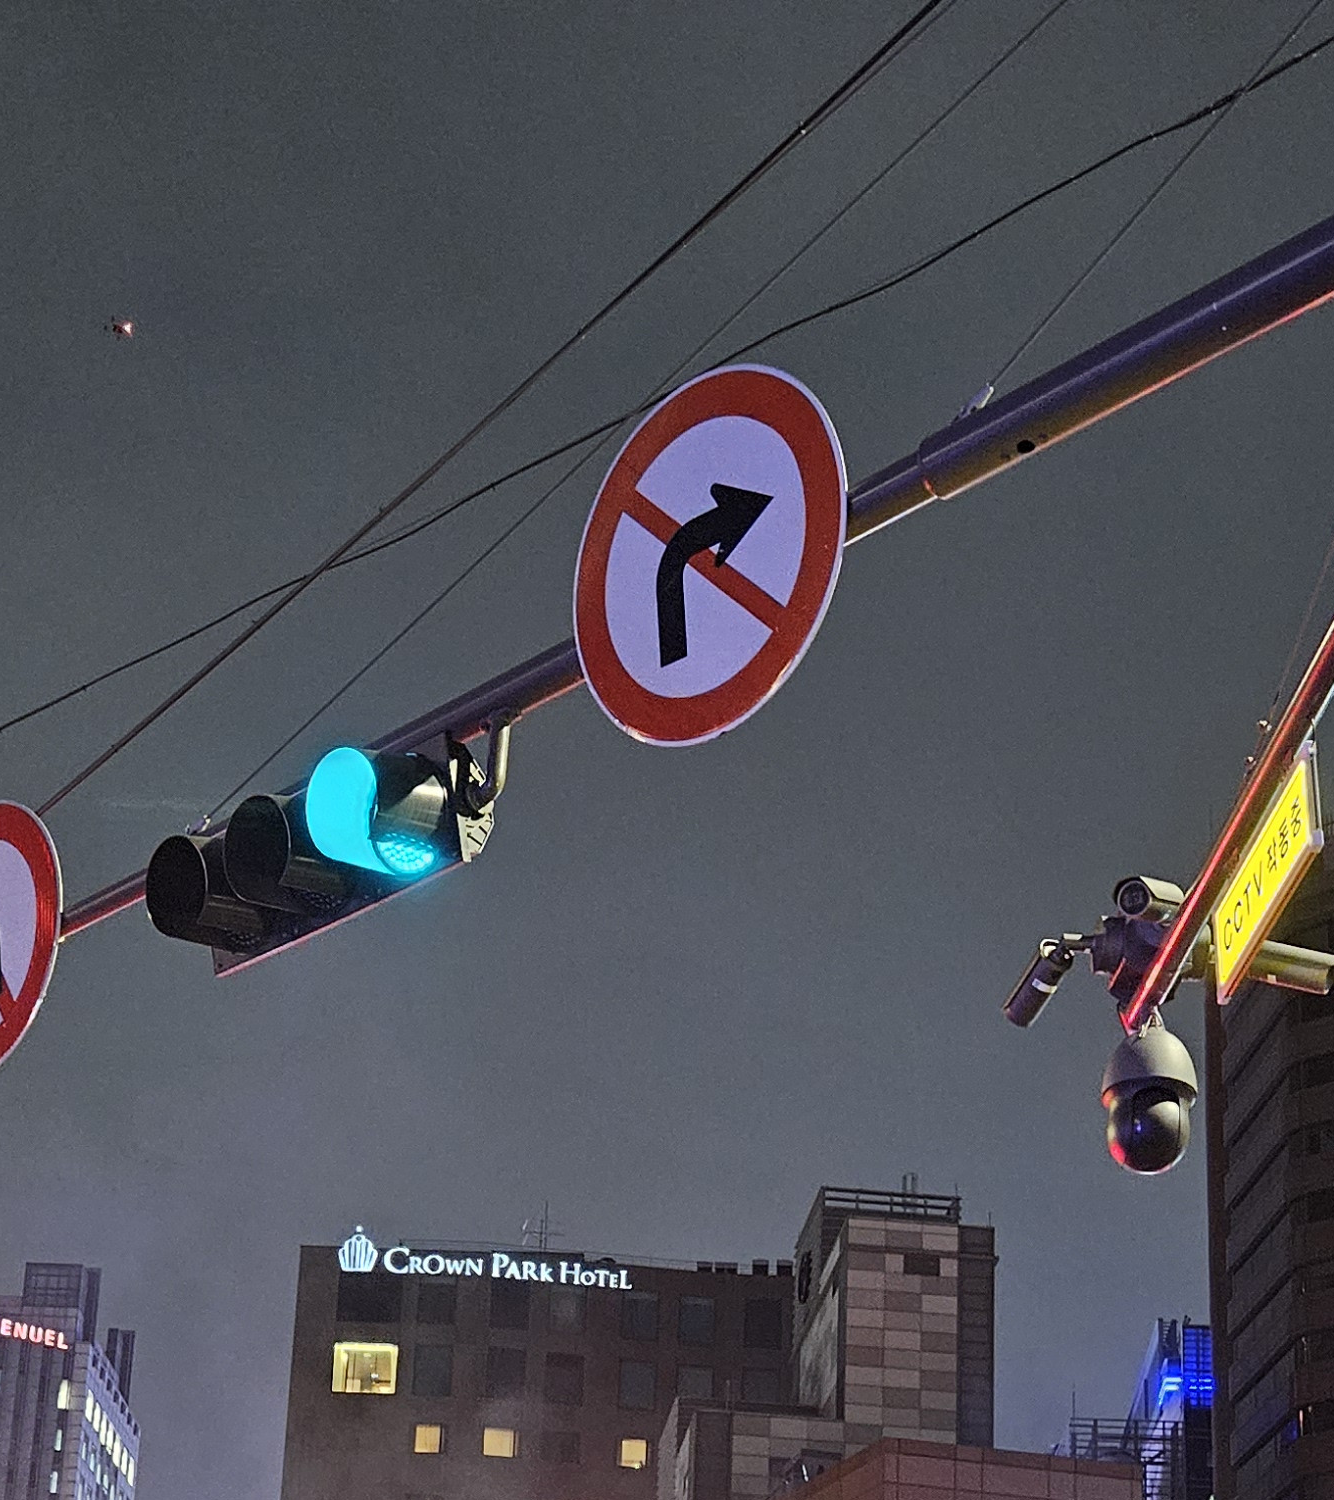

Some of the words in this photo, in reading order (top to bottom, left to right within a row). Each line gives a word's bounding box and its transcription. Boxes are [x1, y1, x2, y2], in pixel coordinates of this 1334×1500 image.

[1221, 860, 1267, 952] CCTV
[1265, 795, 1304, 876] 작동중
[383, 1247, 483, 1277] CROWN
[491, 1252, 554, 1284] PARK
[559, 1261, 633, 1290] HOTEL
